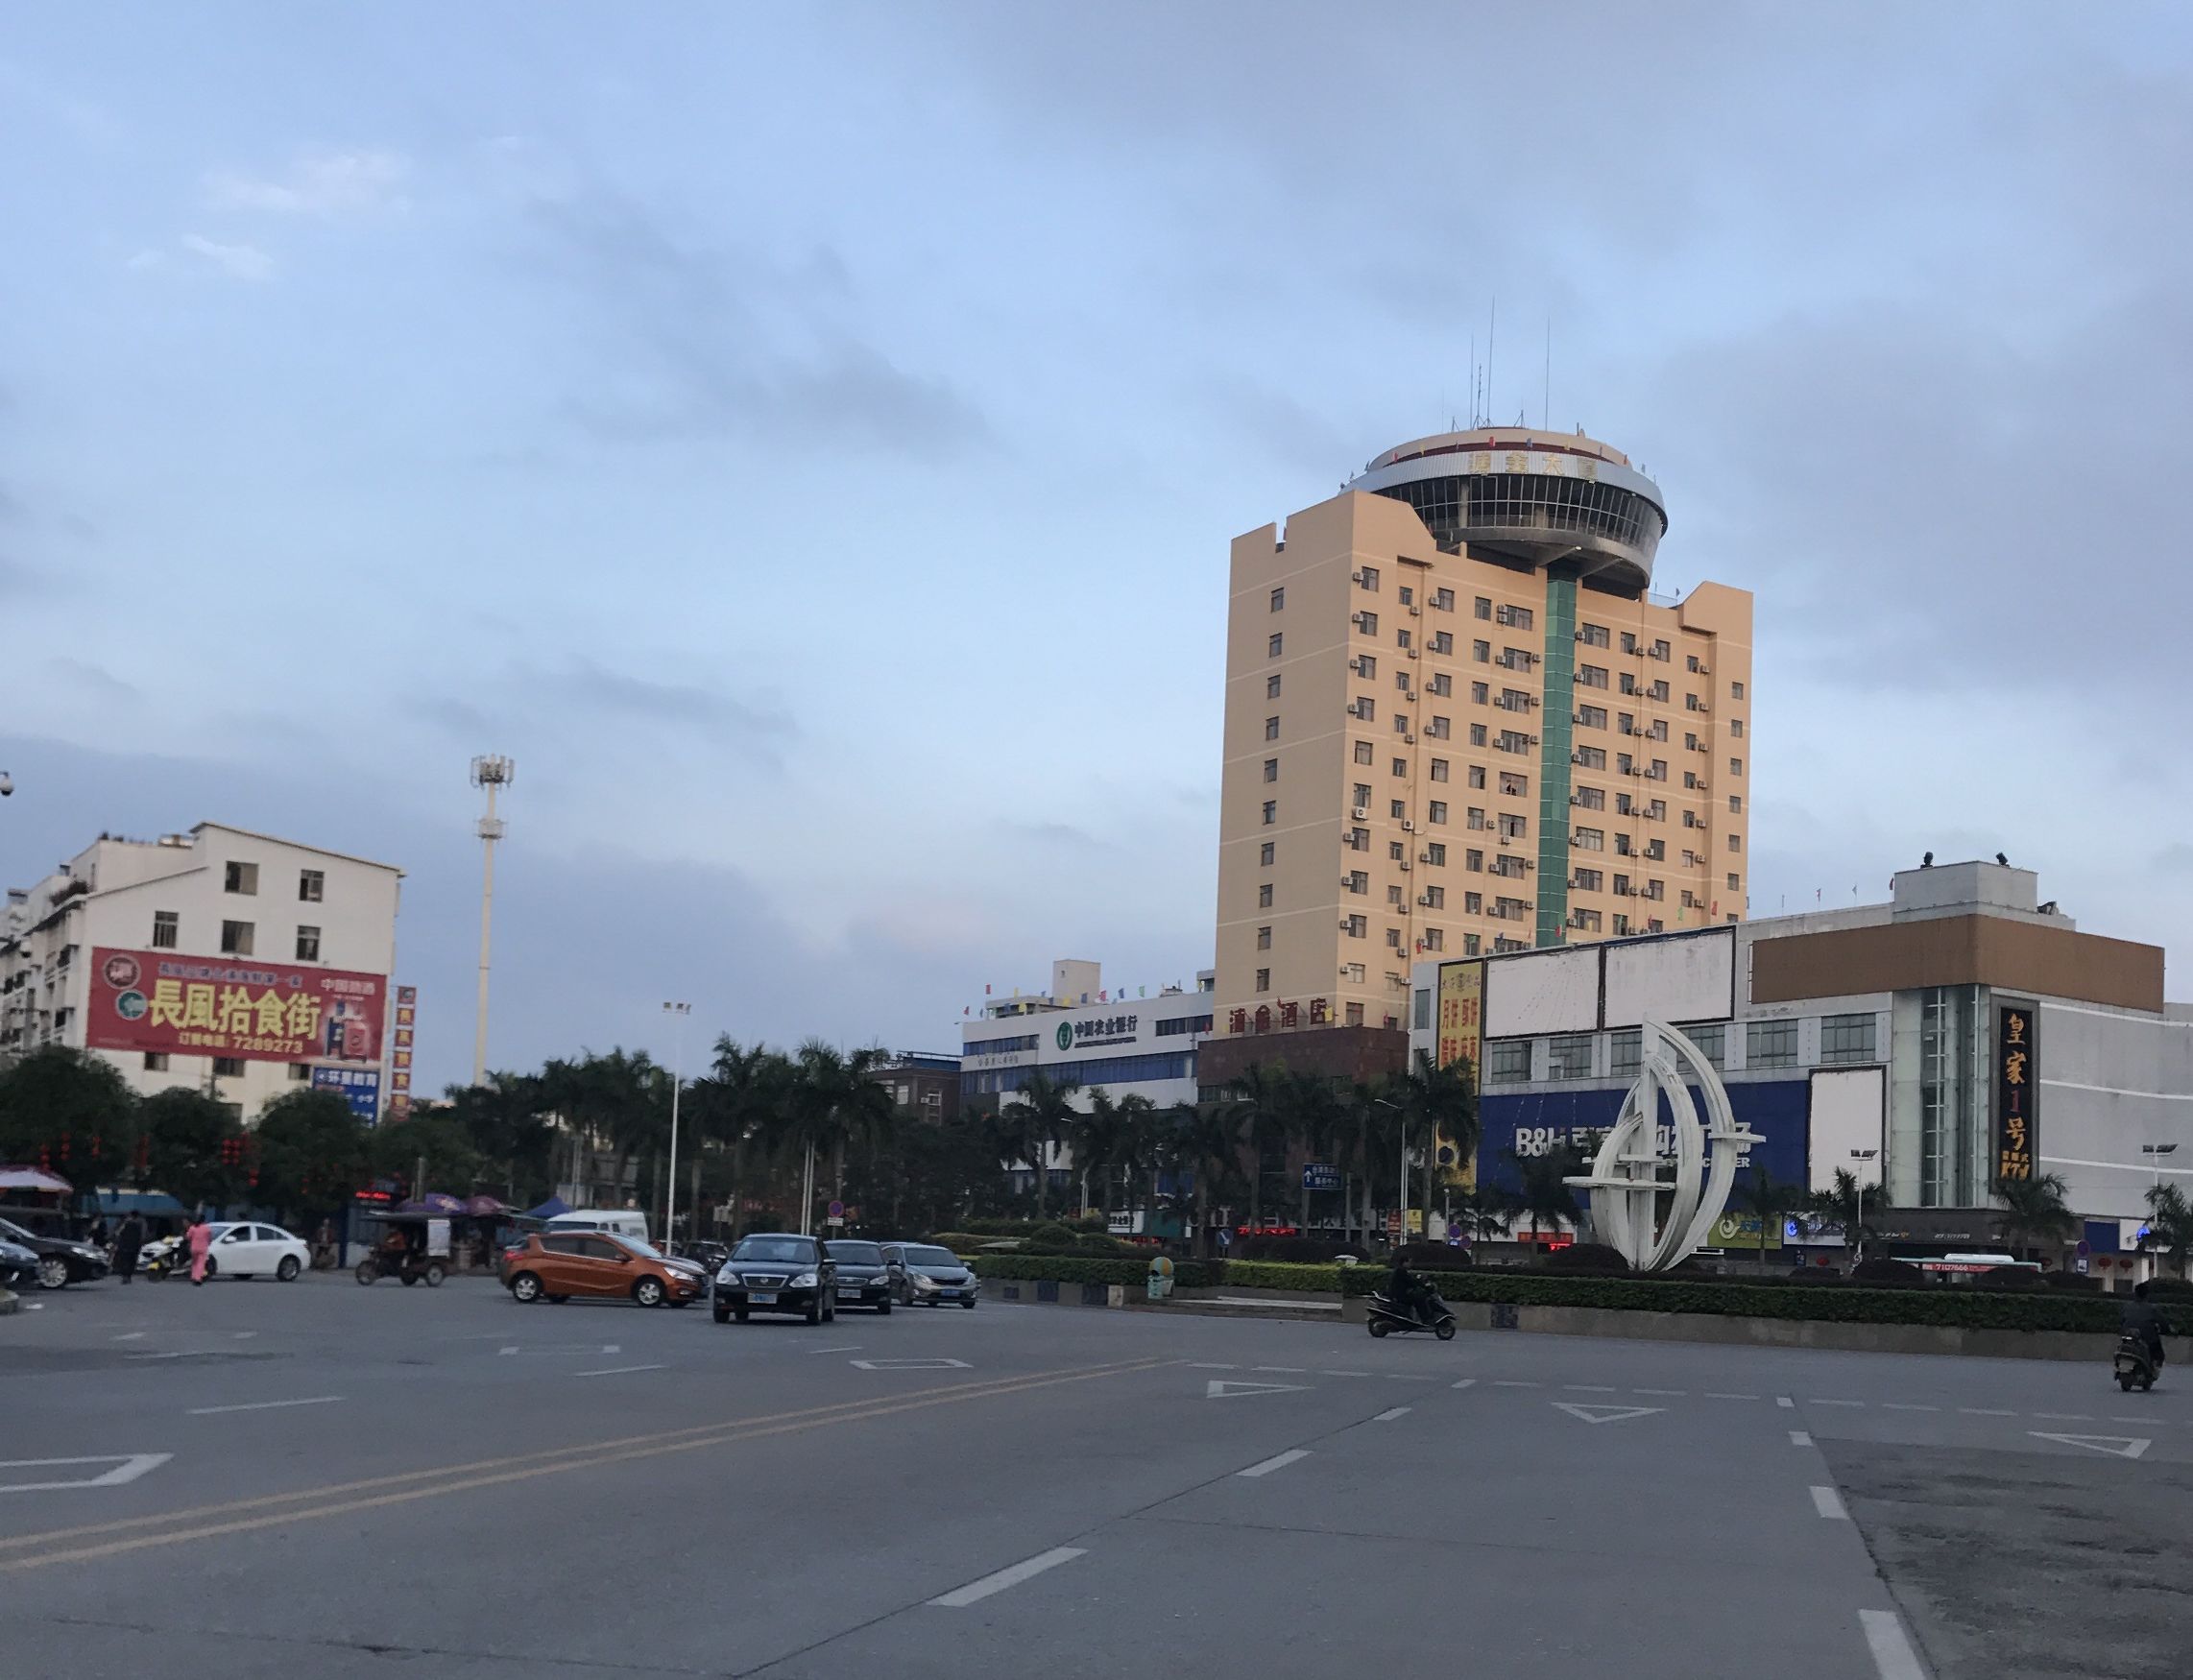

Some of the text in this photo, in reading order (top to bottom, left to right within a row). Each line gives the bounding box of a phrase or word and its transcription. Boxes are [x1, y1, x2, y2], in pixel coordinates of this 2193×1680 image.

[1073, 1015, 1138, 1038] 中国农业银行
[2005, 1013, 2028, 1151] 皇家1号
[2000, 1162, 2031, 1182] KTV
